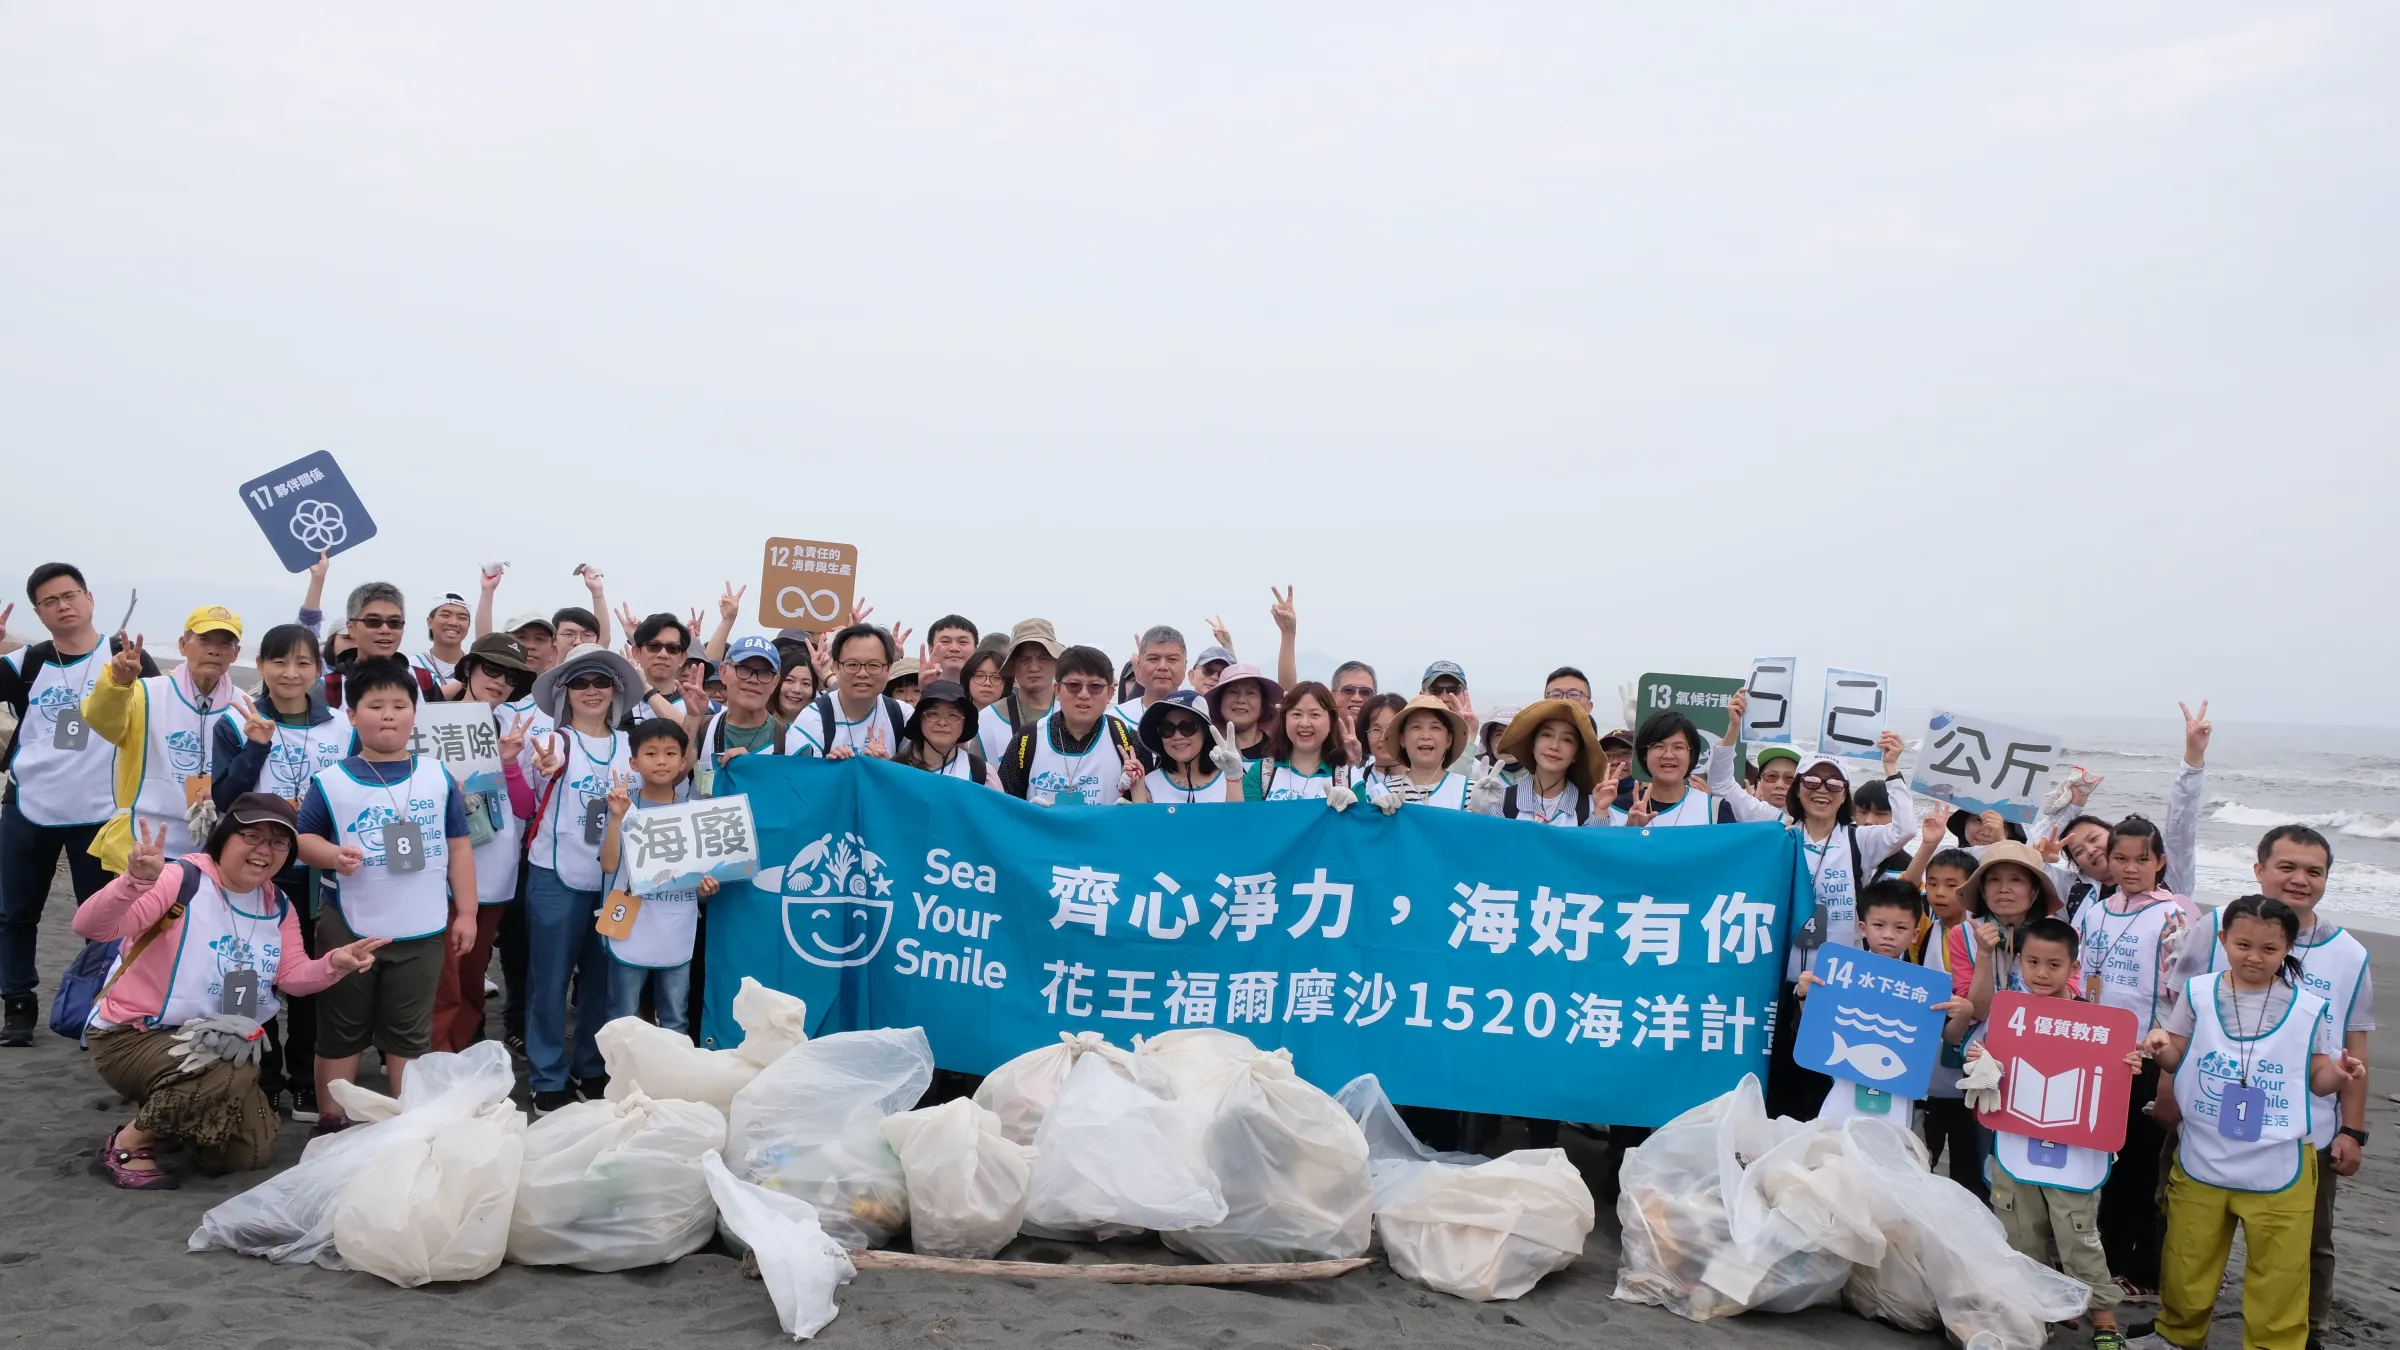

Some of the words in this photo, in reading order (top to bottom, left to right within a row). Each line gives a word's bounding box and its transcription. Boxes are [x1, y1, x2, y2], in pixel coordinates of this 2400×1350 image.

[250, 485, 274, 511] 17
[273, 467, 325, 498] 夥伴關係
[770, 546, 790, 567] 12
[793, 545, 841, 561] 負責任的
[791, 559, 852, 576] 消費與生產
[744, 638, 772, 651] GAP
[1648, 684, 1672, 709] 13
[66, 720, 79, 736] 6
[317, 742, 339, 754] Sea
[1929, 726, 2052, 797] 公斤
[1079, 775, 1099, 785] Sea
[626, 787, 639, 797] our
[409, 799, 435, 812] Sea
[407, 814, 438, 827] Your
[595, 812, 606, 829] 3
[421, 828, 442, 842] mile
[629, 805, 749, 869] 海廢
[396, 836, 412, 855] 8
[923, 847, 997, 894] Sea
[1824, 868, 1847, 879] Sea
[1821, 882, 1850, 893] Your
[1820, 895, 1853, 906] Smile
[610, 904, 627, 923] 3
[912, 891, 1002, 941] Your
[1047, 865, 1777, 966] 齊心淨力，海好有你
[1804, 917, 1817, 933] 4
[2119, 932, 2139, 944] Sea
[263, 943, 280, 958] Se
[2114, 944, 2139, 957] Your
[261, 958, 278, 973] You
[894, 937, 1007, 990] Smile
[2106, 957, 2140, 972] Smile
[1826, 957, 1854, 989] 14
[1857, 971, 1929, 1004] 水下生命
[2303, 972, 2331, 991] Sea
[234, 985, 248, 1006] 7
[1041, 959, 1778, 1057] 花王福爾摩沙1520海洋計
[2007, 1006, 2026, 1037] 4
[2033, 1015, 2111, 1045] 優質教育
[2256, 1059, 2284, 1075] Sea
[2252, 1075, 2286, 1091] Your
[2235, 1100, 2248, 1121] 1
